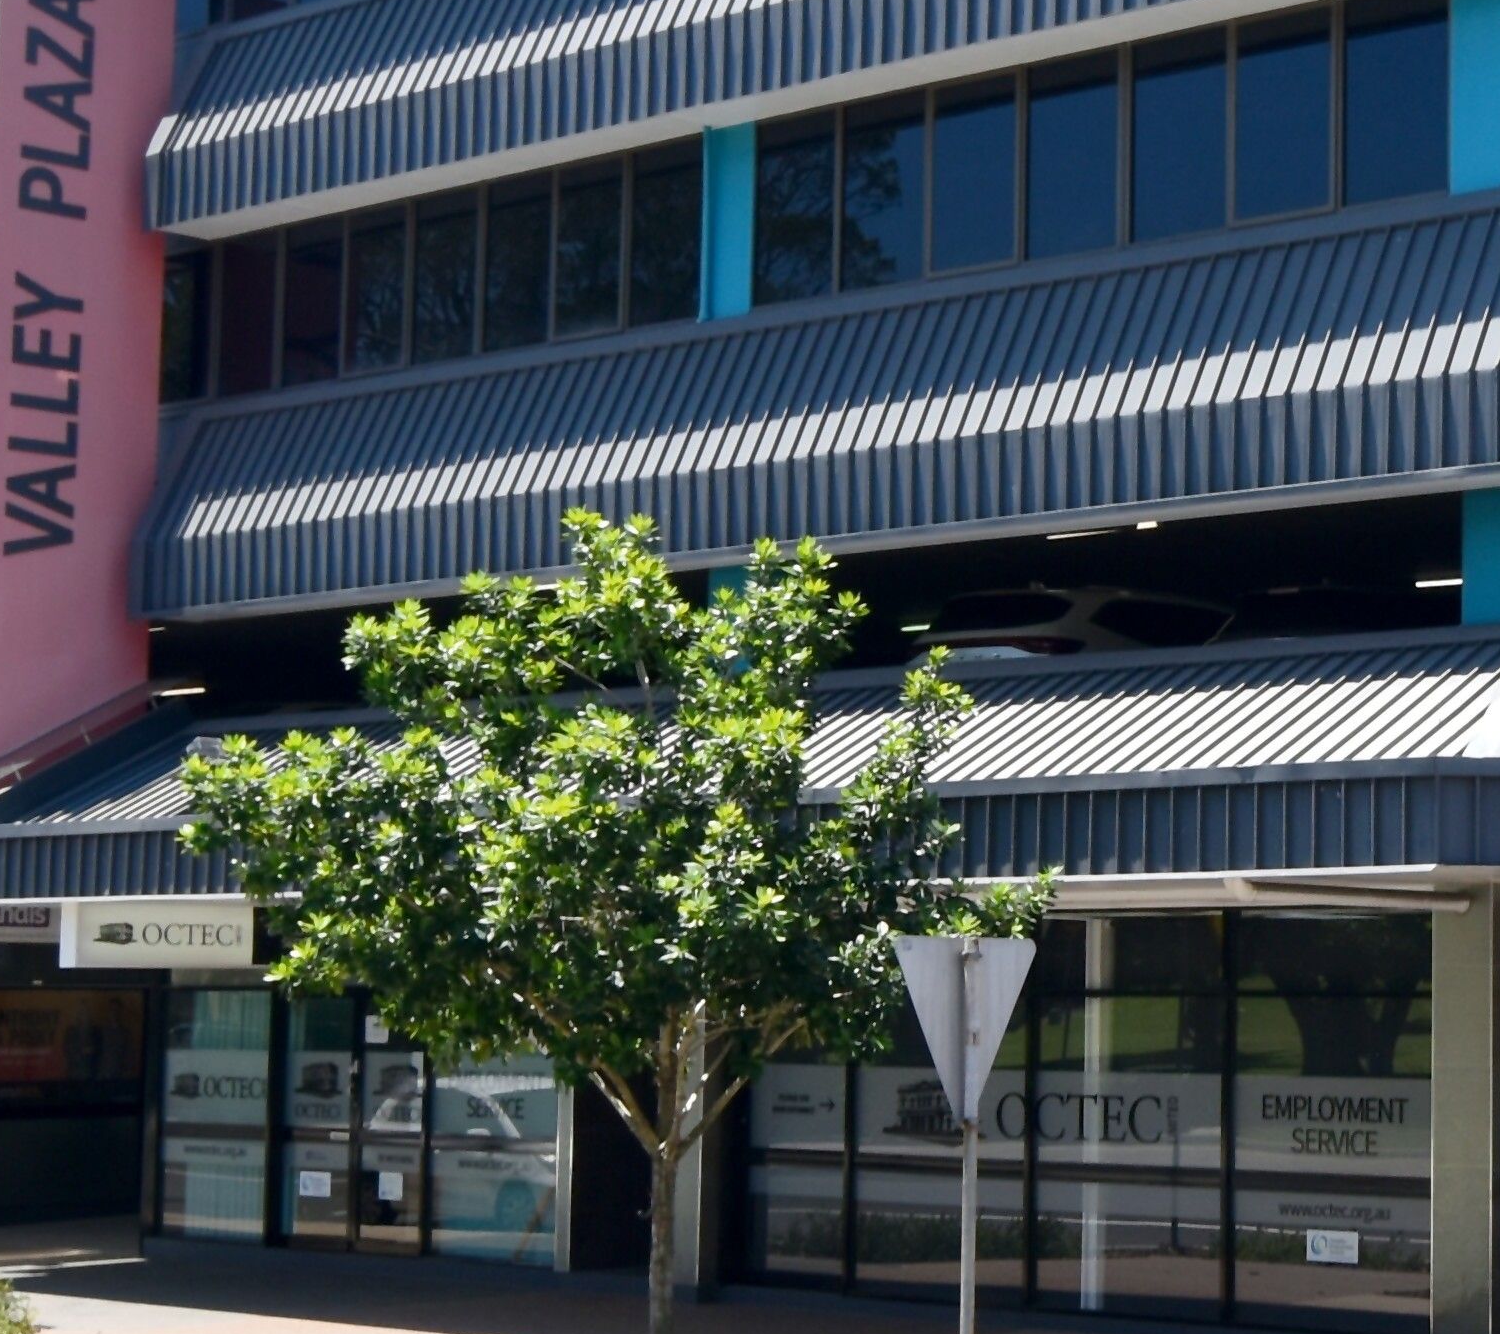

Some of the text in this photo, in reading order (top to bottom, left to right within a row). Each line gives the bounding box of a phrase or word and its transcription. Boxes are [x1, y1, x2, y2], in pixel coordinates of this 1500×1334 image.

[3, 272, 84, 555] VALLEY
[142, 923, 235, 946] OCTEC
[203, 1076, 264, 1099] OCTEC
[996, 1092, 1164, 1143] OCTEC
[1261, 1094, 1410, 1124] EMPLOYMENT
[1291, 1128, 1378, 1156] SERVICE
[1278, 1202, 1391, 1223] www.octec.org.au
